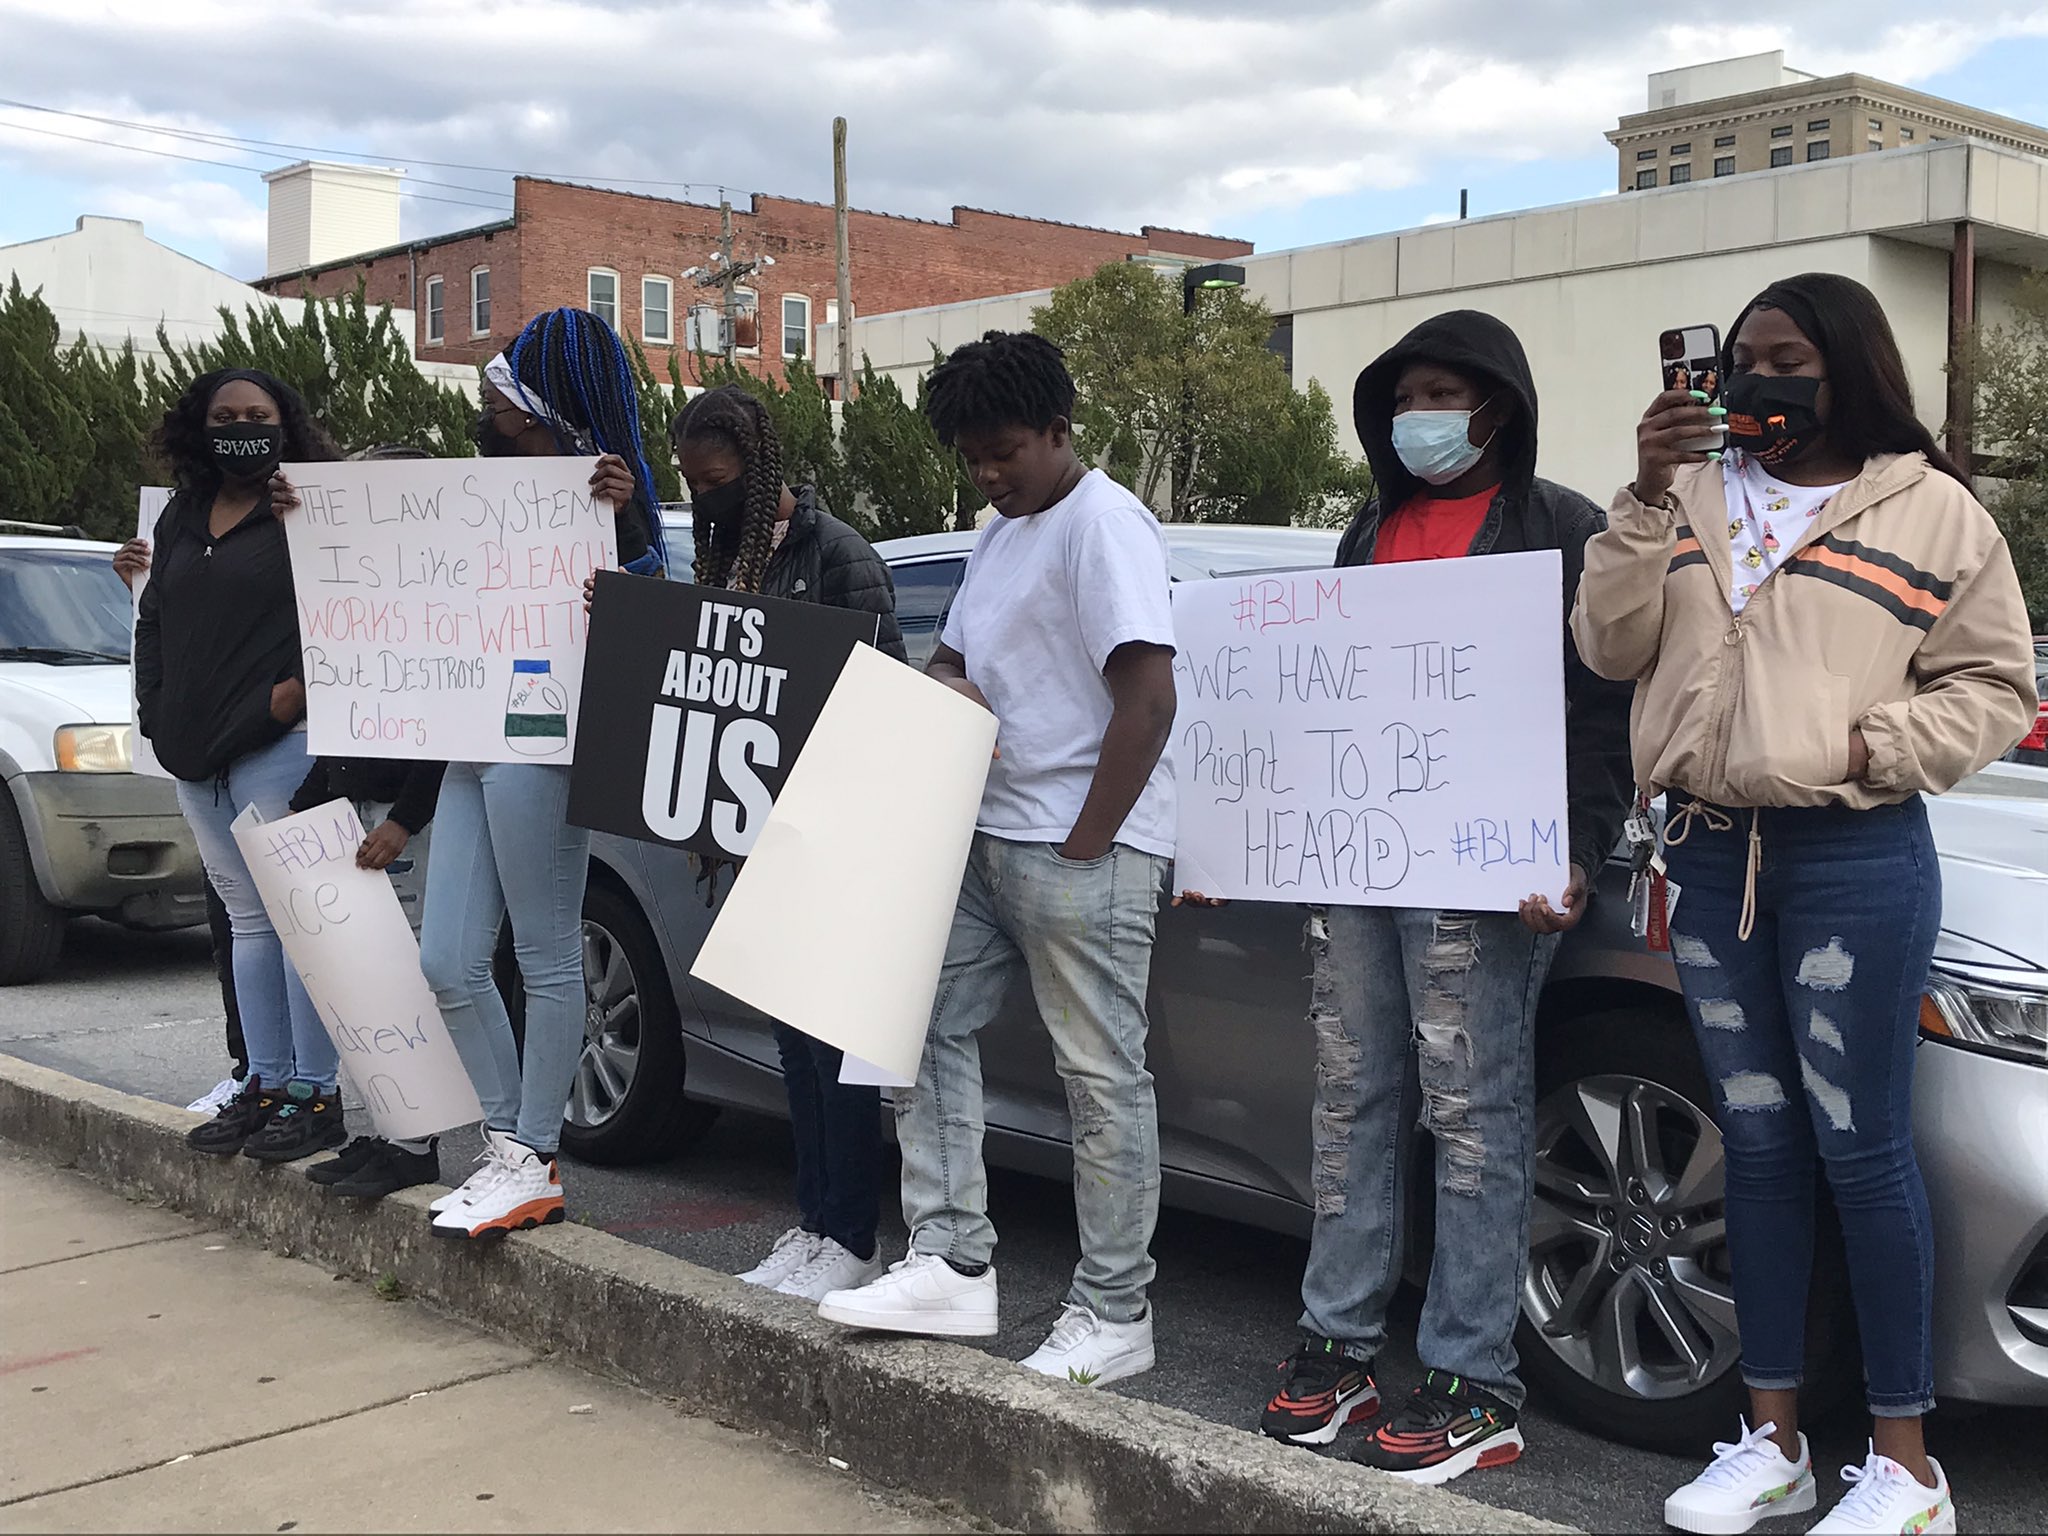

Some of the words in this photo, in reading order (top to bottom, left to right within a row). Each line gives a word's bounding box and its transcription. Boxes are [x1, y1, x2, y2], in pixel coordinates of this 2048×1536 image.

[213, 438, 271, 456] SAVAGE
[295, 485, 348, 526] THE
[299, 596, 408, 643] WORKS
[696, 600, 766, 658] IT'S
[1229, 577, 1352, 636] #BLM
[377, 649, 486, 693] DESTROYS
[660, 649, 788, 716] ABOUT
[1277, 643, 1372, 703] HAVE
[1390, 640, 1478, 701] THE
[641, 703, 780, 857] US
[1183, 720, 1295, 805] Right
[1303, 728, 1370, 801] TO
[1380, 721, 1451, 803] BE
[264, 811, 361, 875] #BLM
[1450, 817, 1561, 873] #BLM
